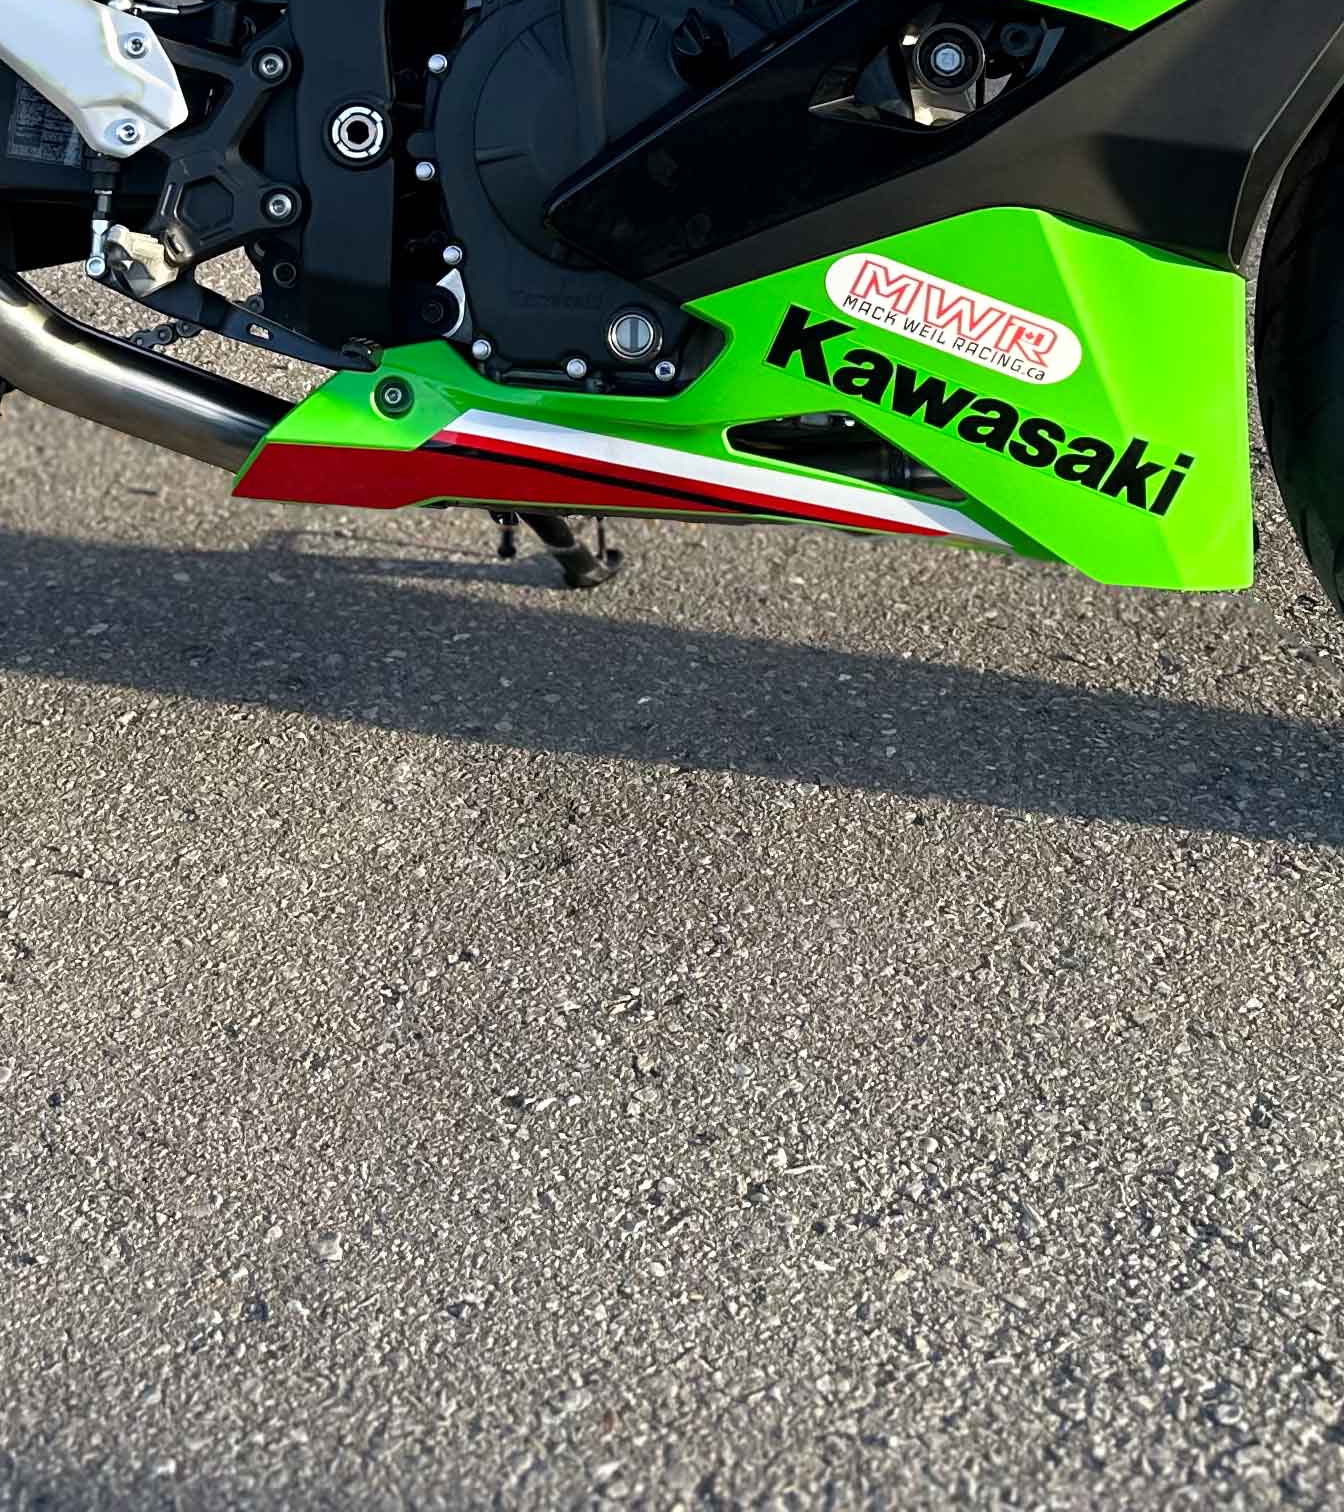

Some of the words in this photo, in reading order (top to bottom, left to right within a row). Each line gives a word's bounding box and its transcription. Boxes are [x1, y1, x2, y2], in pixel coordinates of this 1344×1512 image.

[843, 295, 898, 326] MACK
[904, 316, 946, 345] WEIL
[952, 337, 1046, 381] RACING.ca
[849, 259, 1058, 368] MWR
[766, 304, 1194, 516] Kawasaki
